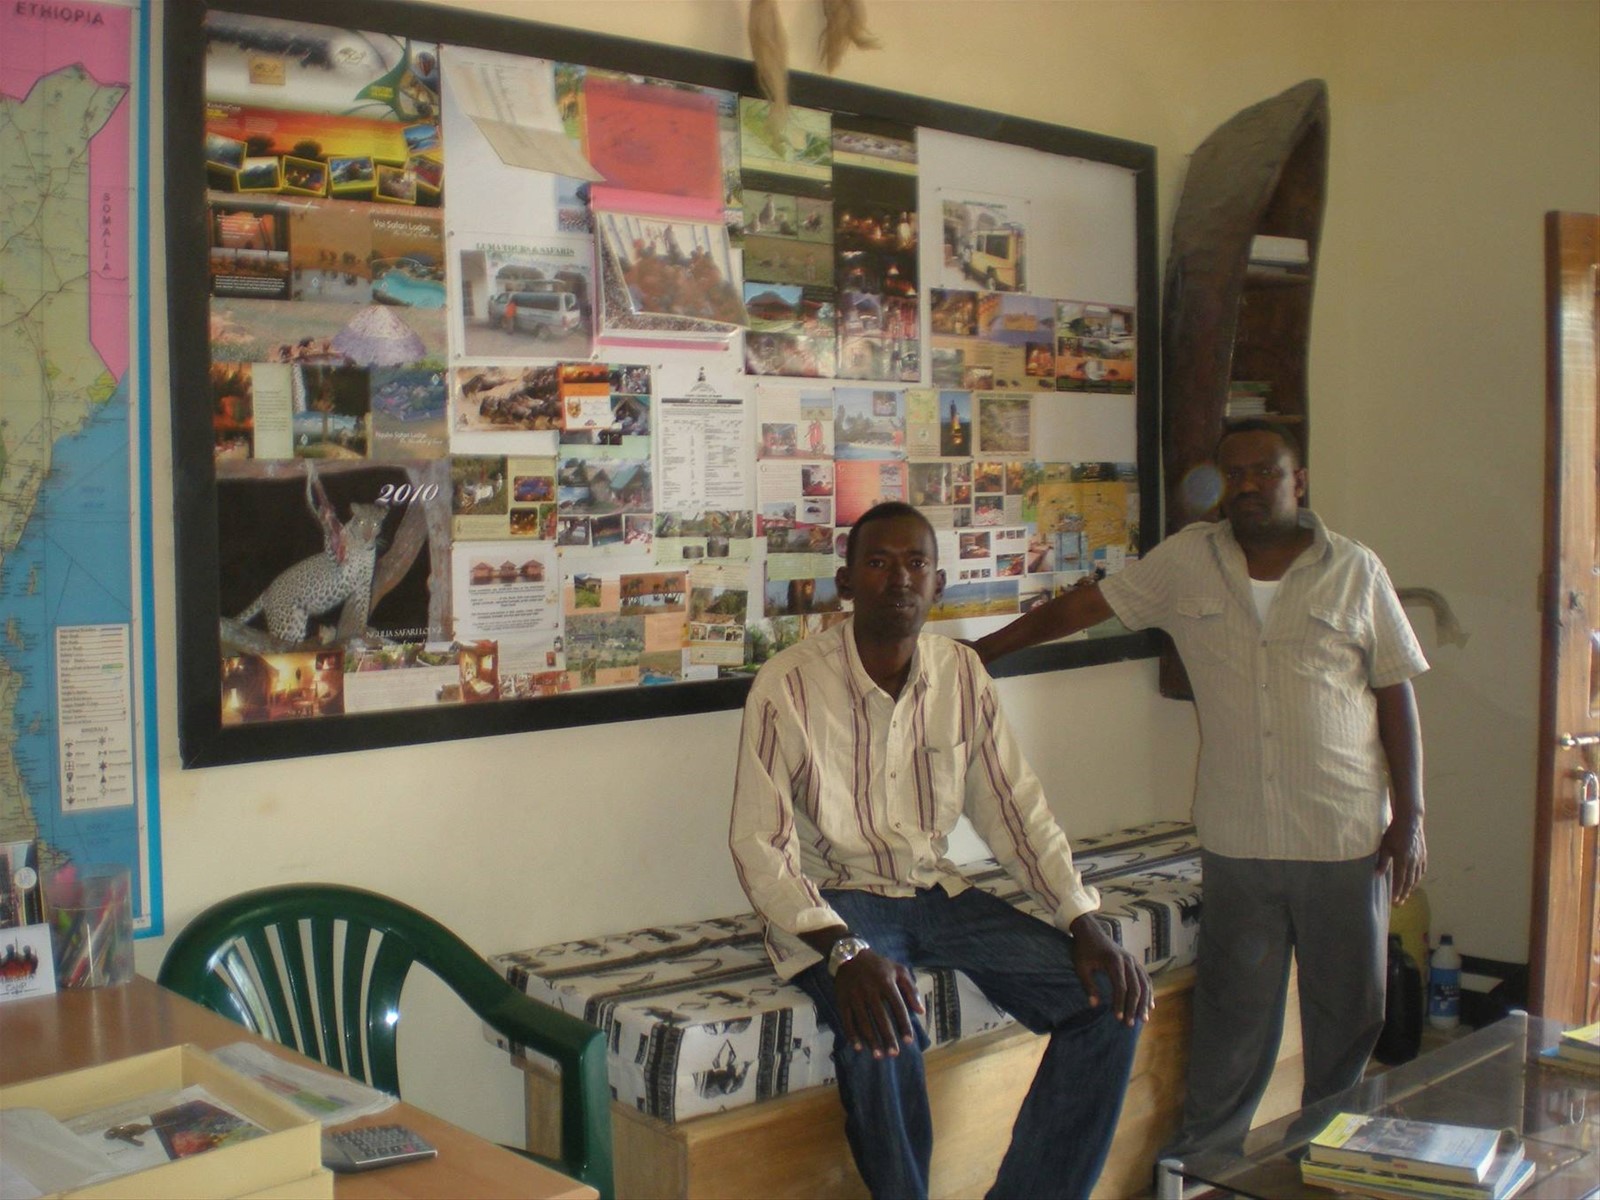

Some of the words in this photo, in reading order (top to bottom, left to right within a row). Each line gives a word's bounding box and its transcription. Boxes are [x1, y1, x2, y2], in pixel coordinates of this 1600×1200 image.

[15, 1, 105, 26] ETHIOPIA
[101, 191, 112, 272] SOMALIA
[386, 220, 407, 230] Safari
[408, 222, 431, 232] Lodge
[540, 247, 575, 257] SAFARIS
[377, 483, 439, 504] 2010
[394, 628, 419, 638] SAFARI
